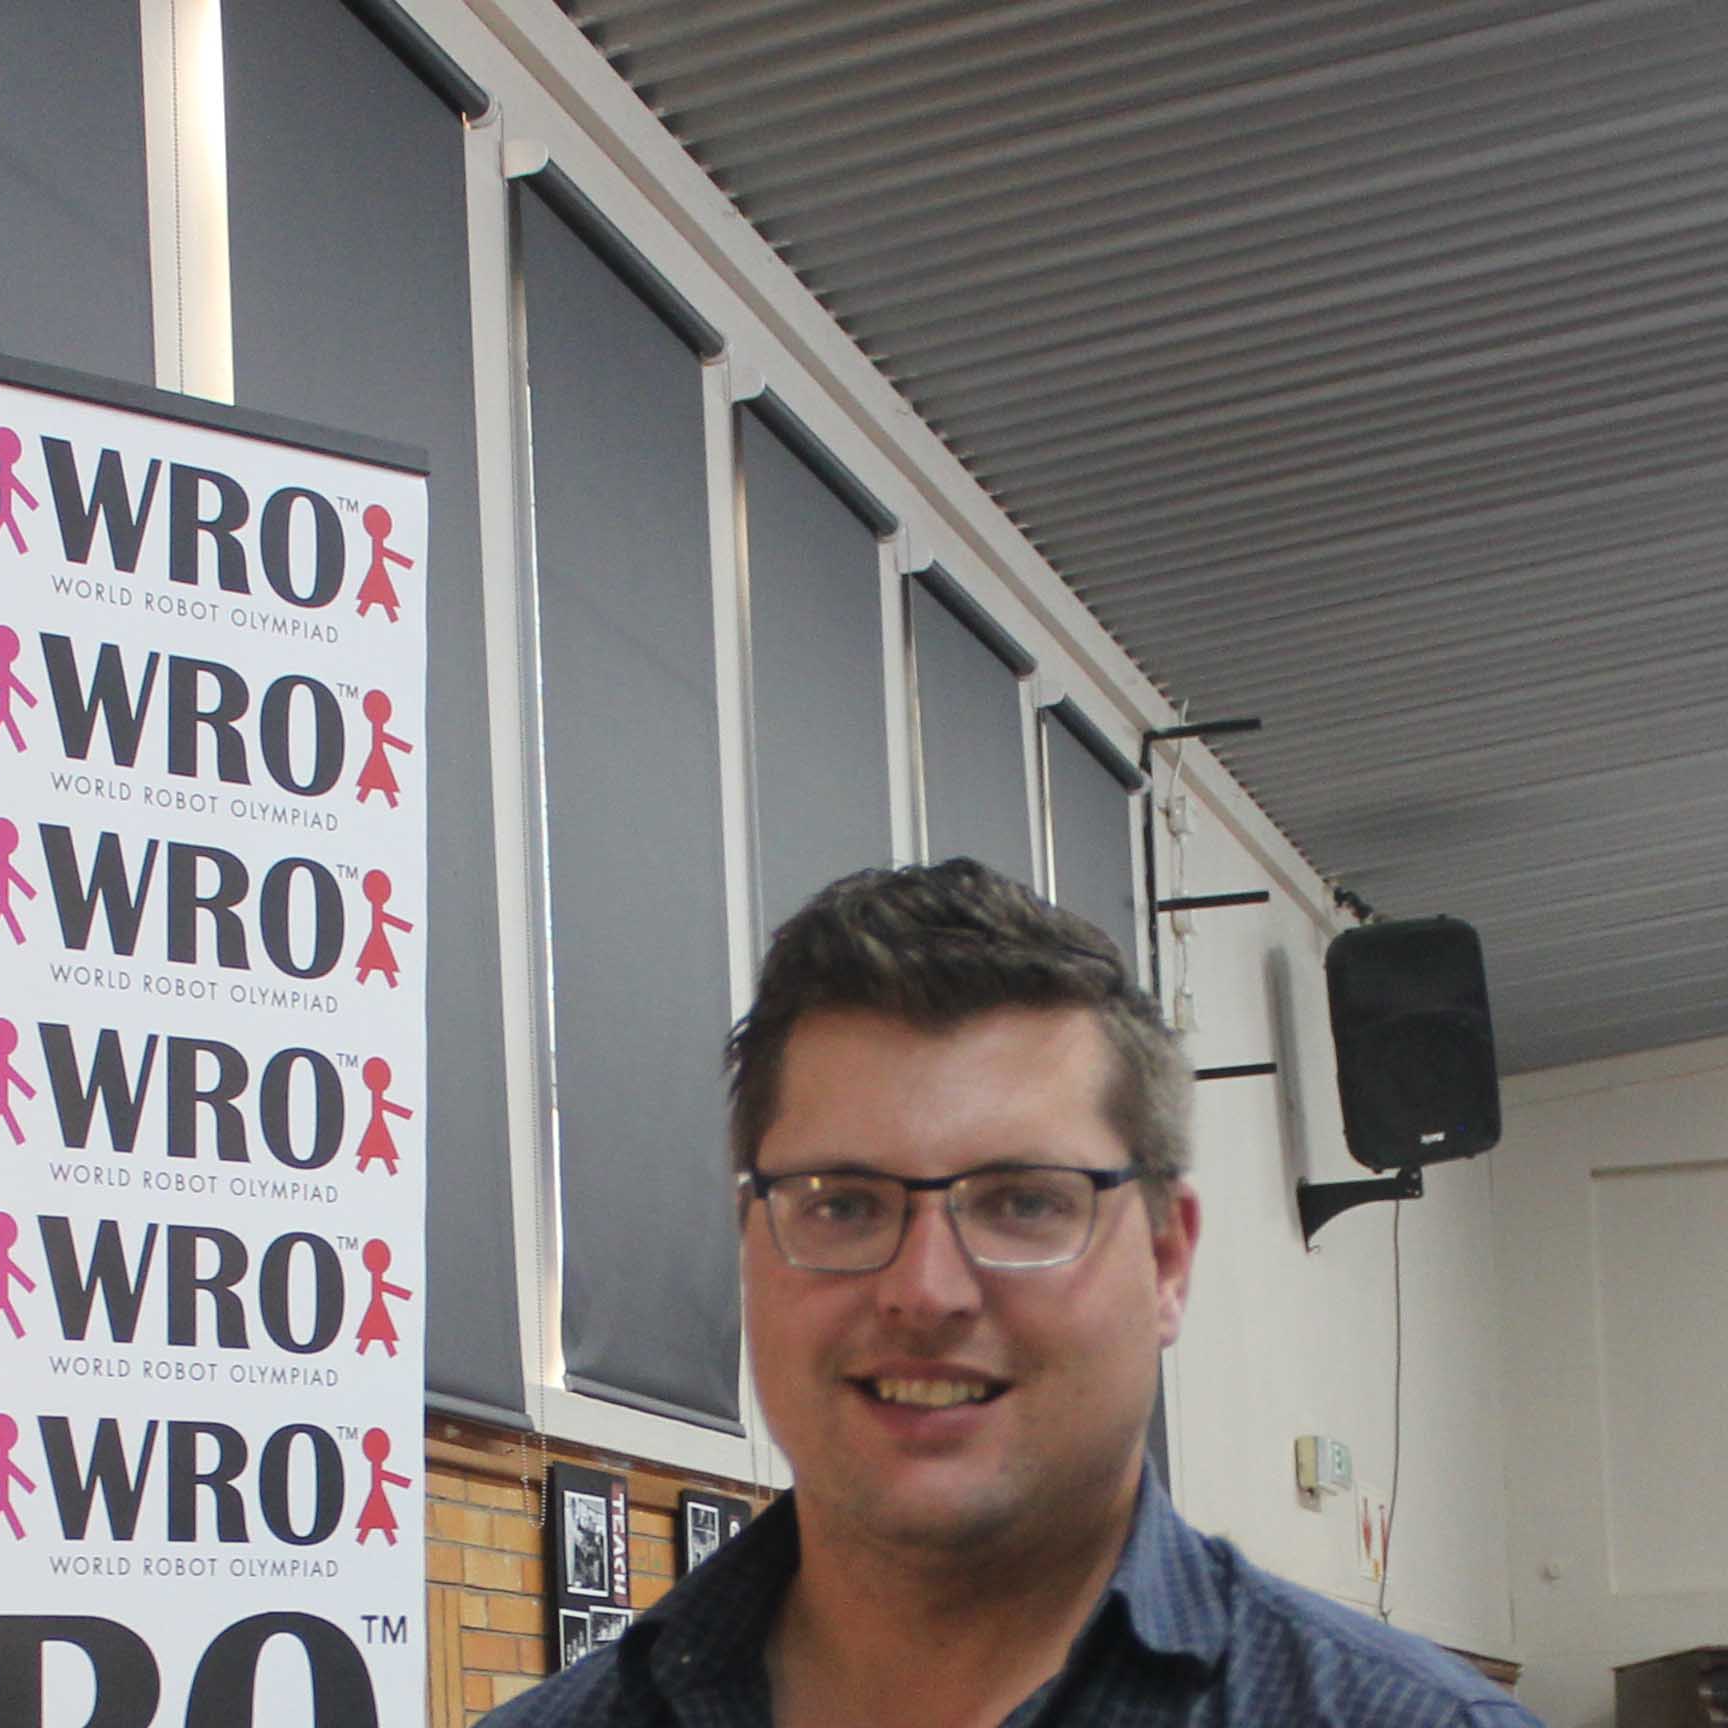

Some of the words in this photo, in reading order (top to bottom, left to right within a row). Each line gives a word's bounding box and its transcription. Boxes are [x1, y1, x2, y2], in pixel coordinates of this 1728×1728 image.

[41, 436, 345, 608] WRO
[51, 575, 133, 606] WORLD
[145, 592, 219, 622] ROBOT
[230, 608, 339, 644] OLYMPIAD
[40, 632, 345, 796] WRO
[50, 771, 132, 800] WORLD
[144, 785, 219, 814] ROBOT
[230, 799, 339, 832] OLYMPIAD
[39, 823, 344, 979] WRO
[50, 964, 131, 990] WORLD
[143, 974, 218, 1002] ROBOT
[230, 984, 339, 1014] OLYMPIAD
[38, 1022, 344, 1169] WRO
[49, 1163, 131, 1187] WORLD
[143, 1170, 218, 1195] ROBOT
[229, 1178, 339, 1204] OLYMPIAD
[38, 1215, 344, 1354] WRO
[49, 1356, 131, 1379] WORLD
[143, 1360, 218, 1382] ROBOT
[229, 1363, 339, 1388] OLYMPIAD
[38, 1416, 345, 1546] WRO
[49, 1556, 131, 1577] WORLD
[143, 1557, 218, 1578] ROBOT
[229, 1558, 339, 1579] OLYMPIAD
[611, 1492, 627, 1595] TEACH
